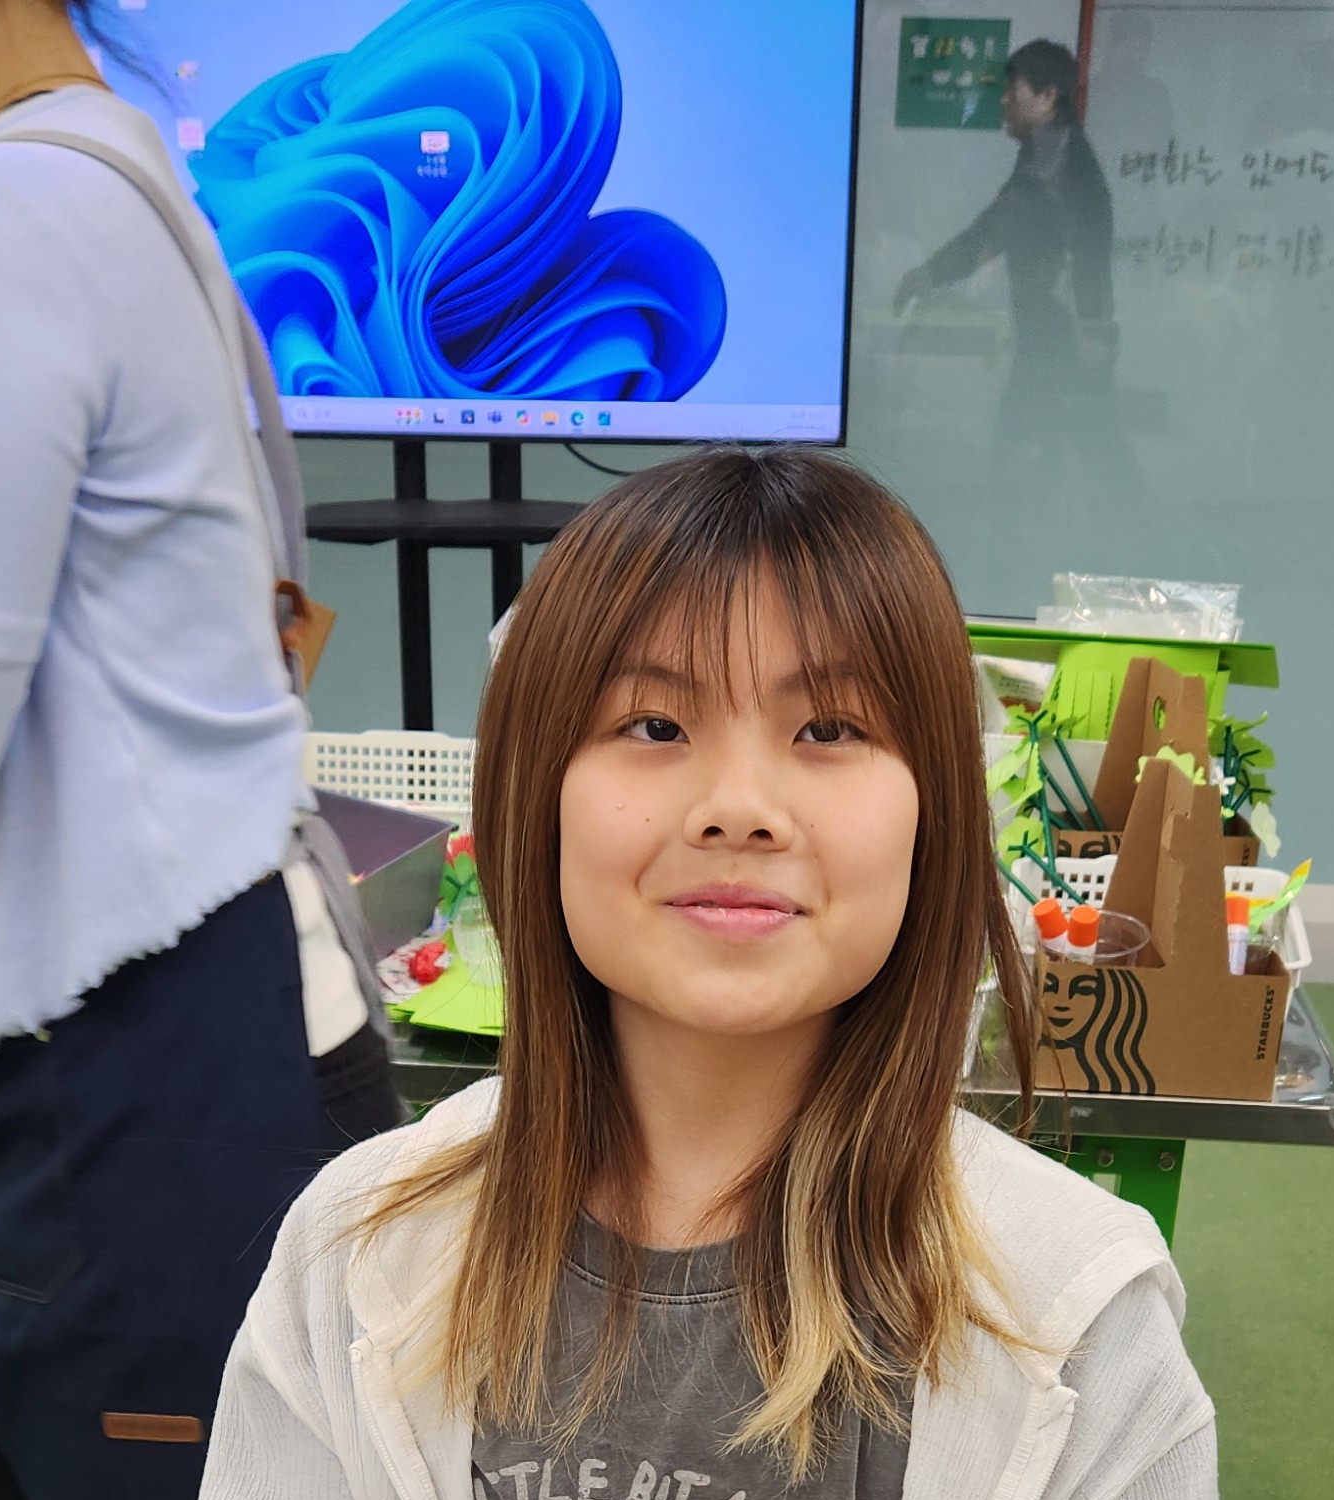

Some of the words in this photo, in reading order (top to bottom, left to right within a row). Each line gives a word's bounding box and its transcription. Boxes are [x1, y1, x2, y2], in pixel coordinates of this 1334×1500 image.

[1120, 138, 1222, 184] 변화는
[1242, 151, 1334, 188] 있어도
[1256, 987, 1275, 1061] STARBUCKS
